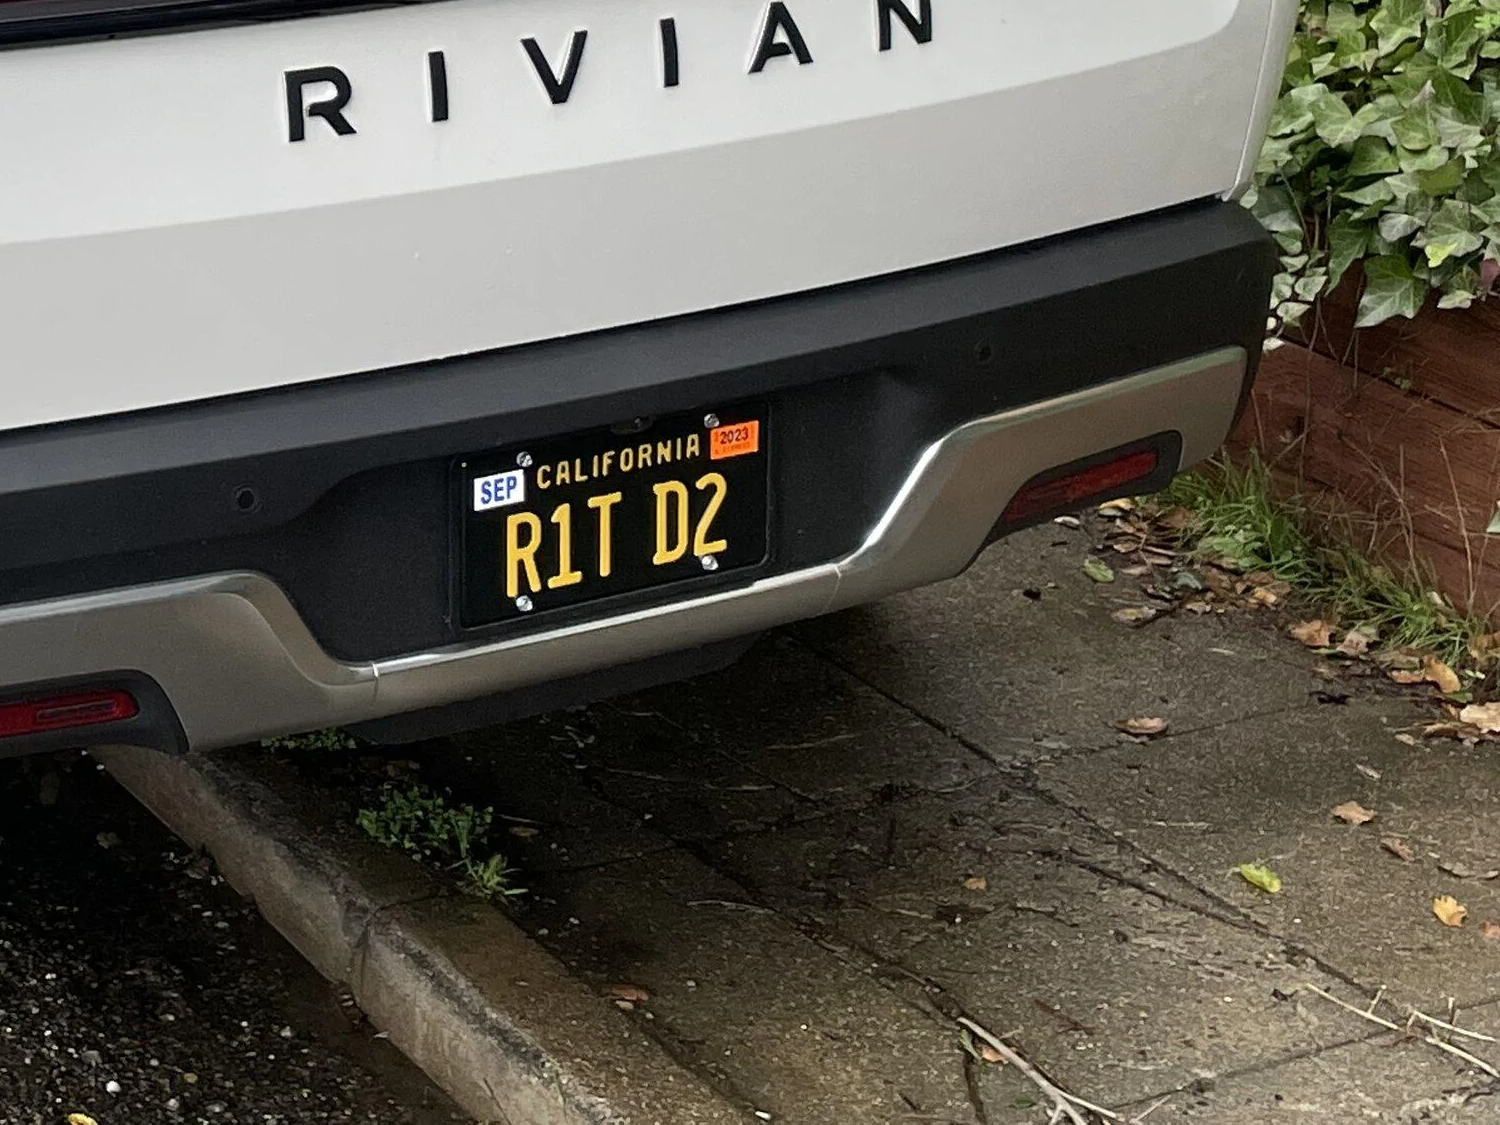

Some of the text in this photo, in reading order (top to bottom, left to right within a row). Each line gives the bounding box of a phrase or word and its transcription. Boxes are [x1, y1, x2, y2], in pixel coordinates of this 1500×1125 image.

[719, 426, 749, 445] 2023
[536, 433, 701, 490] CALIFORNIA
[481, 475, 518, 505] SEP
[506, 472, 728, 598] R1T D2
